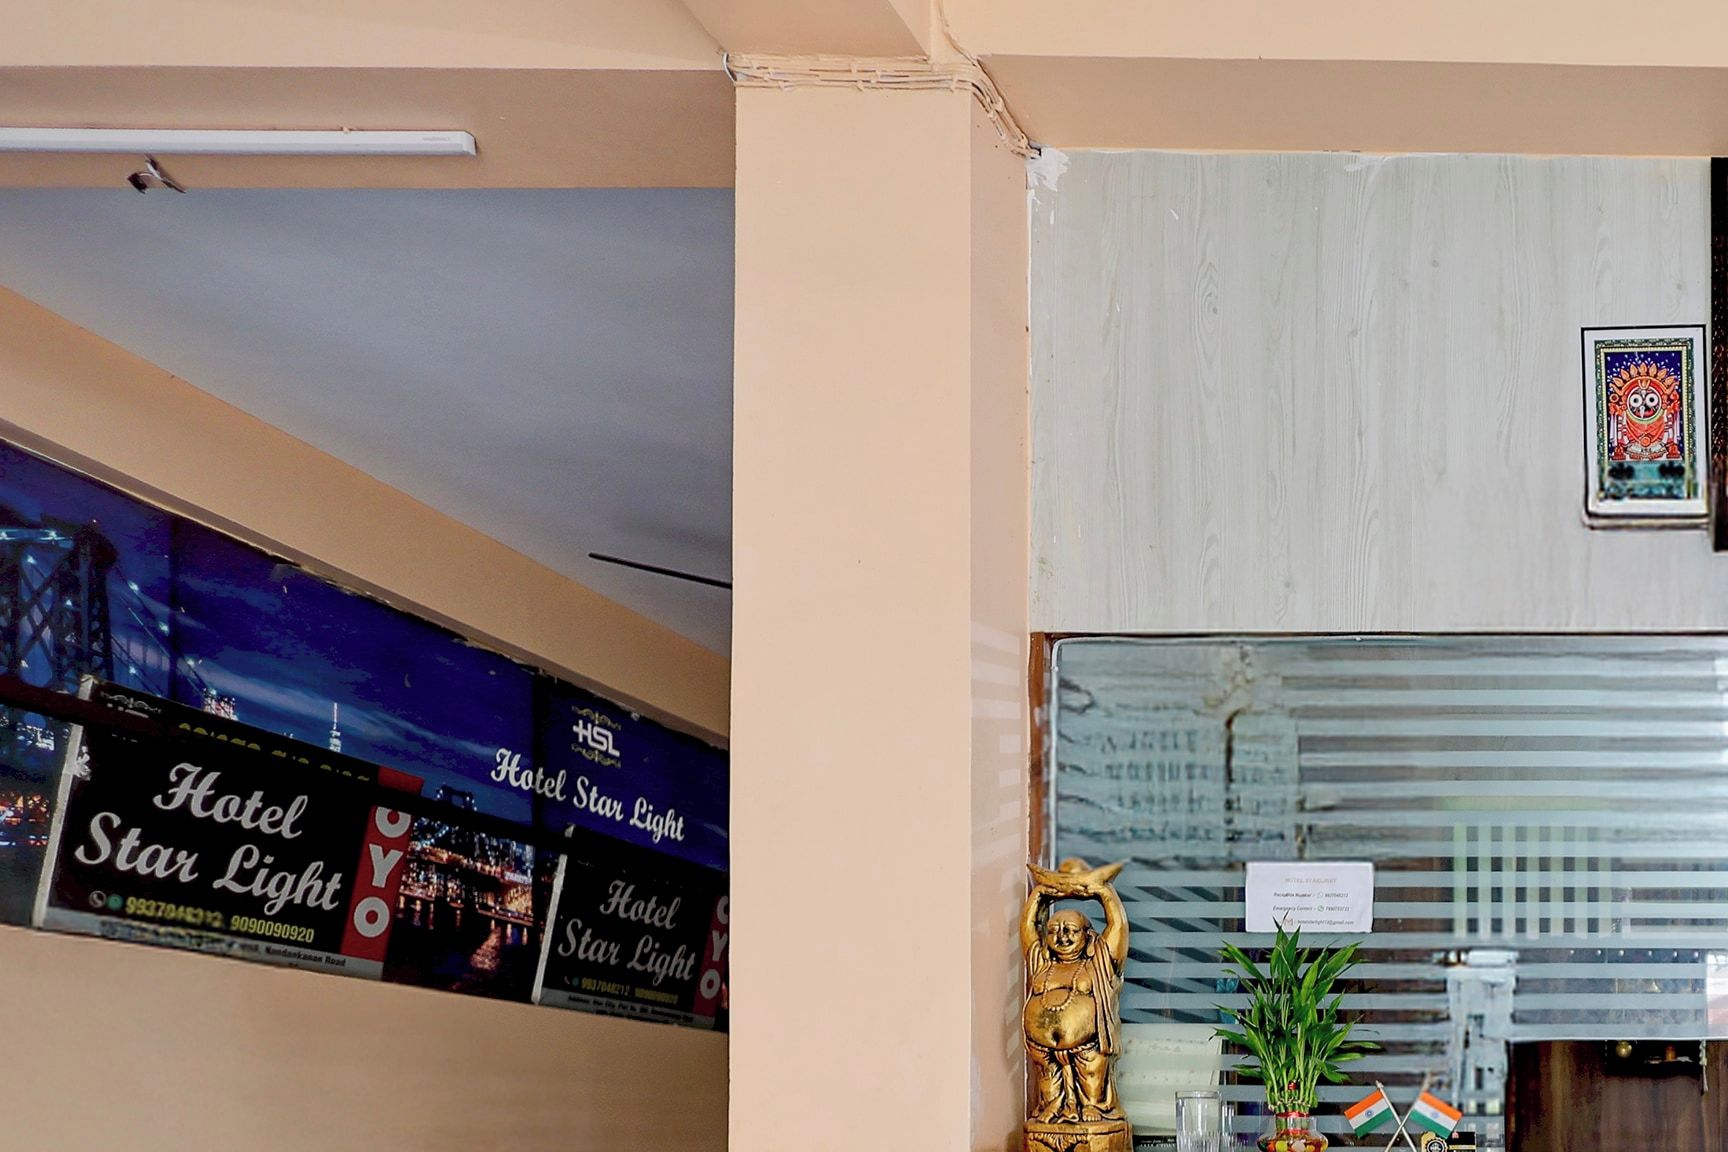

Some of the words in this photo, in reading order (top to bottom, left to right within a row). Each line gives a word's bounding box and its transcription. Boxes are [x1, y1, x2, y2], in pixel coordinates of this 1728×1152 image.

[572, 719, 621, 758] HSL
[153, 762, 308, 839] Hotel
[490, 748, 567, 801] Hotel
[573, 776, 624, 821] Star
[629, 797, 685, 844] Light
[74, 811, 199, 883] Star
[212, 844, 342, 916] Light
[230, 914, 315, 944] 9090090920
[599, 879, 682, 930] Hotel
[557, 917, 621, 967] Star
[626, 934, 696, 987] Light
